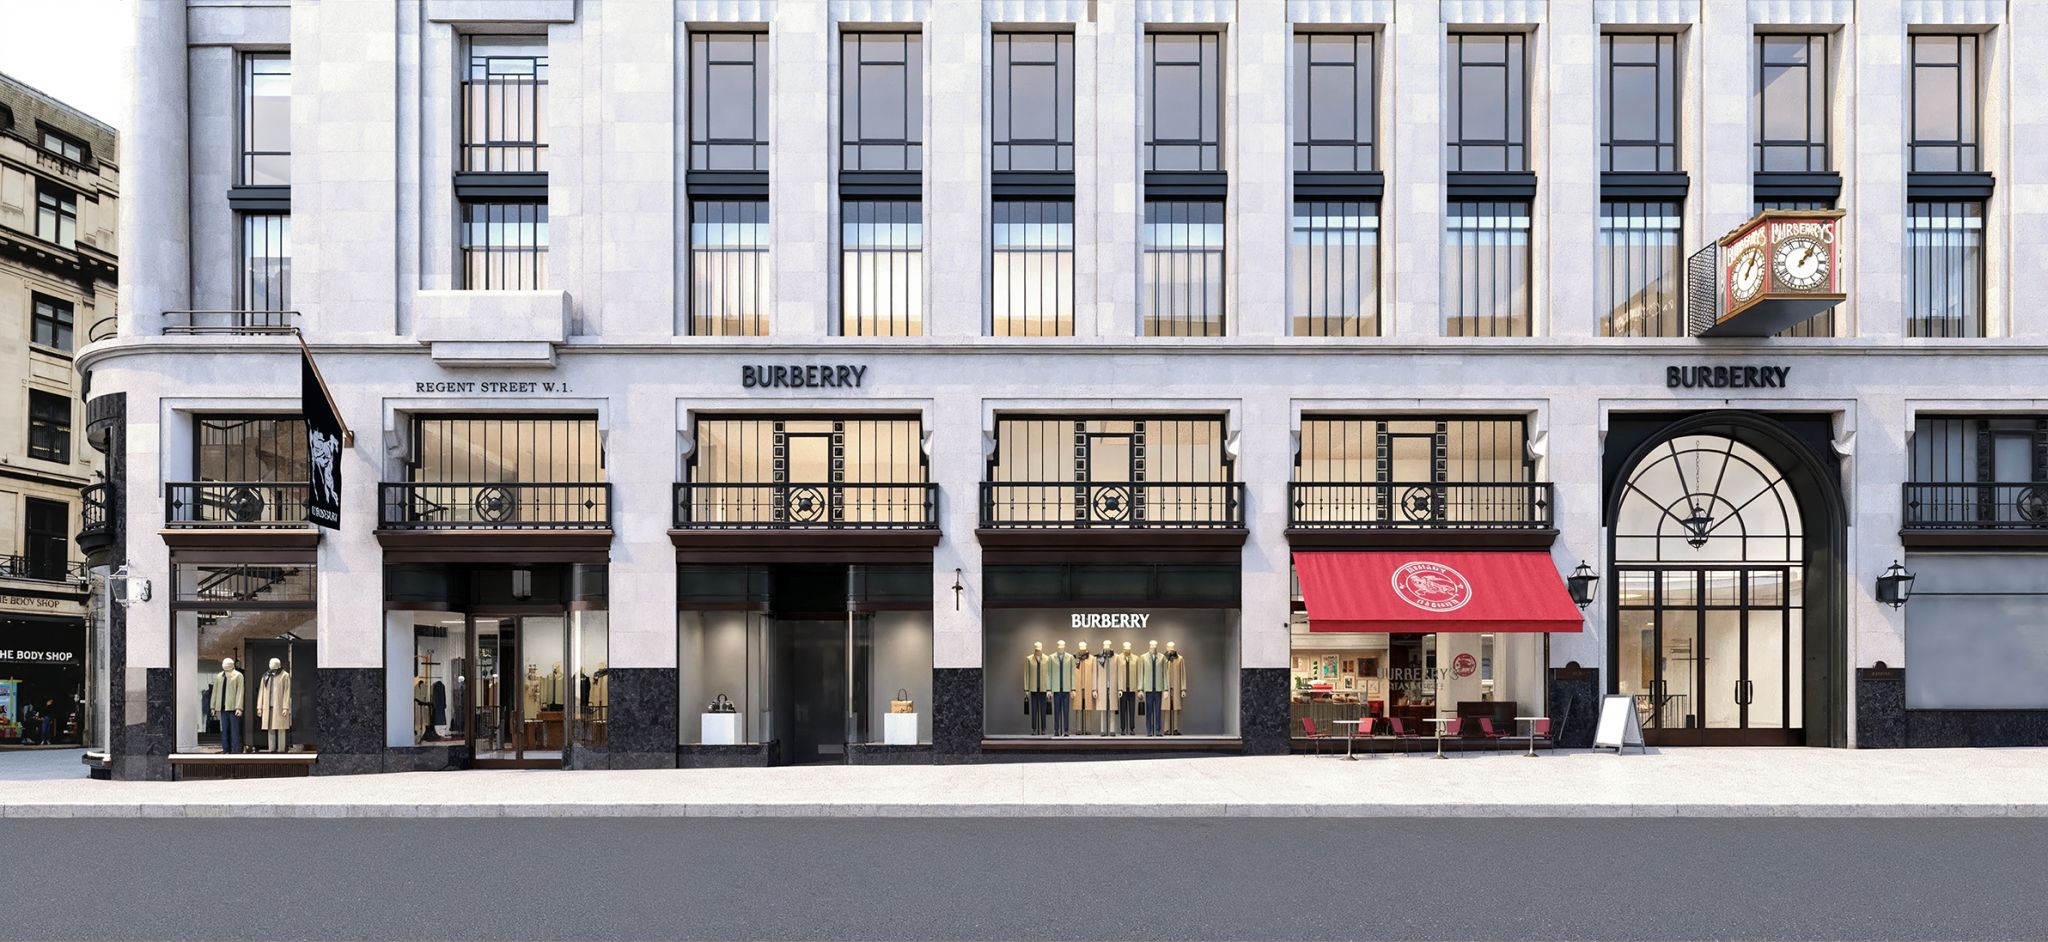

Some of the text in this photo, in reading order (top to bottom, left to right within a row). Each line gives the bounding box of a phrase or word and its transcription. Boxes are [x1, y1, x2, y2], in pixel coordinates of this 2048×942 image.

[742, 365, 867, 388] BURBERRY
[1666, 365, 1791, 388] BURBERRY
[416, 382, 573, 393] REGENT STREET W.1.
[37, 599, 60, 608] SHOP
[1071, 613, 1150, 628] BURBERRY
[16, 650, 44, 660] BODY
[45, 651, 73, 661] SHOP
